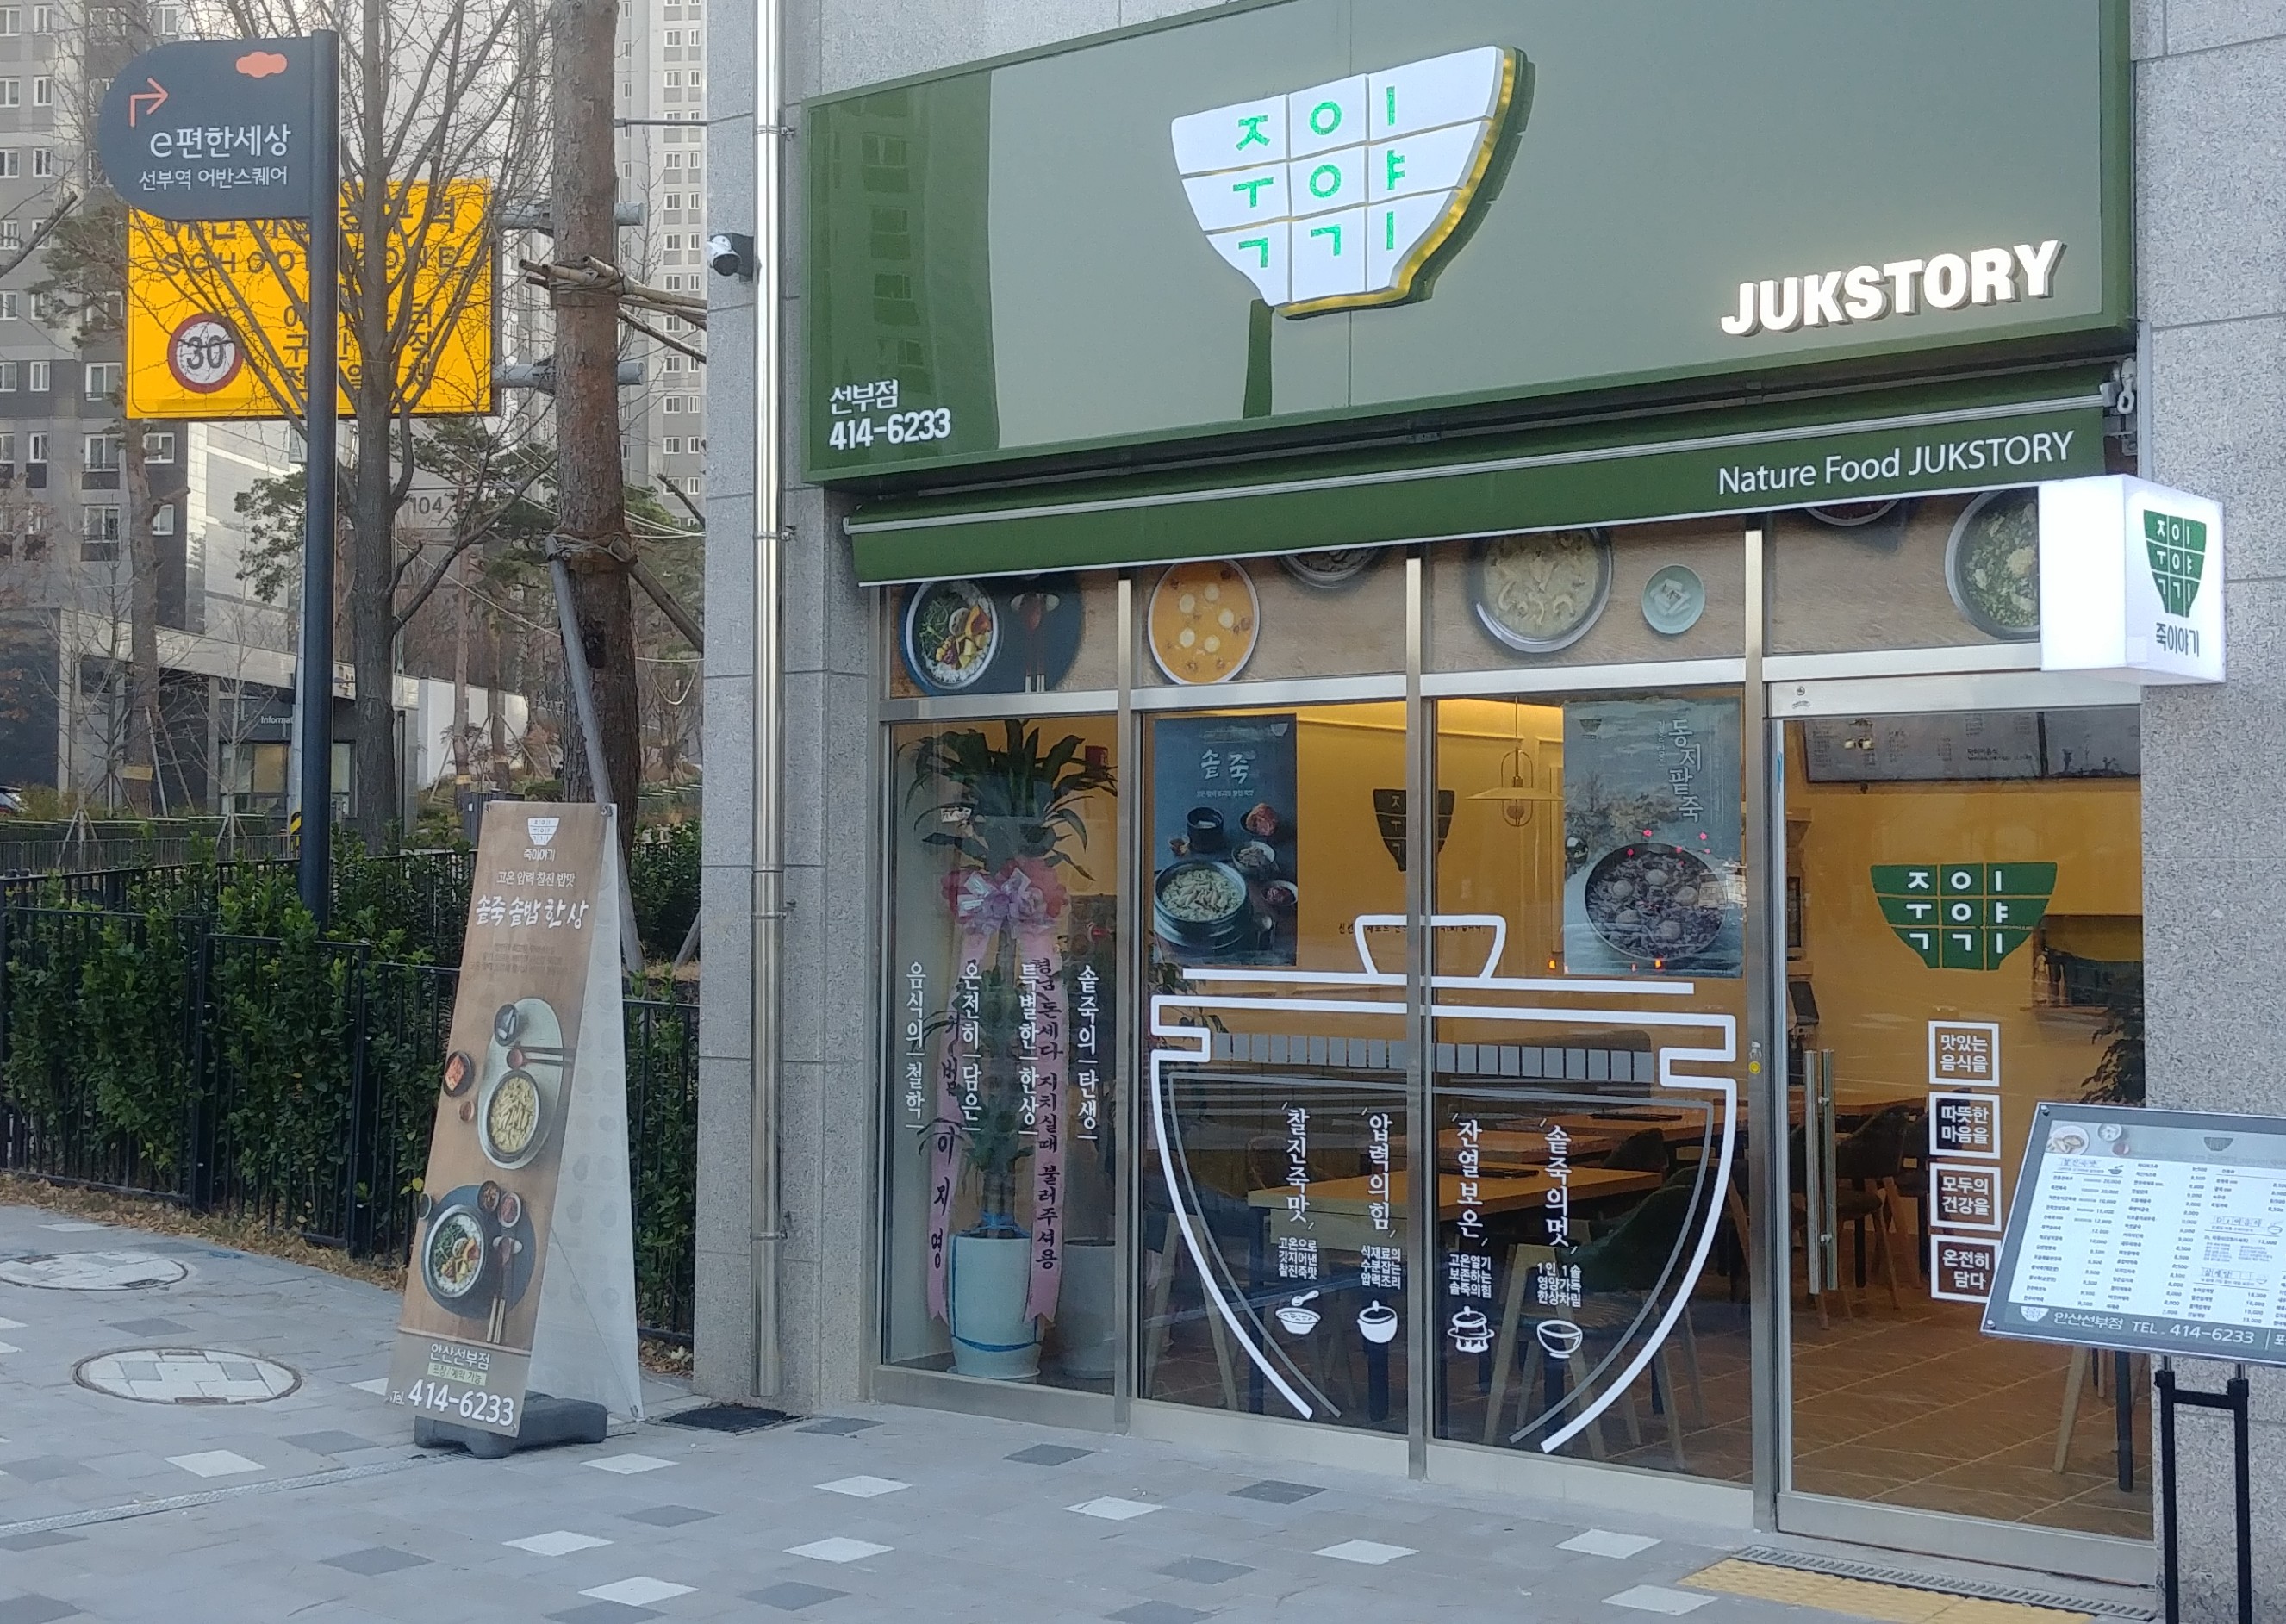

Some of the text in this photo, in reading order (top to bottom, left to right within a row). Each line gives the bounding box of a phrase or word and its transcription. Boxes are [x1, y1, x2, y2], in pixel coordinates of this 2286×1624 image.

[149, 123, 292, 159] e편한세상
[139, 165, 288, 191] 선부역 어반스퀘어
[1720, 240, 2068, 337] JUKSTORY
[185, 334, 227, 370] 30
[829, 378, 900, 415] 선부점
[829, 407, 952, 451] 414-6233
[1718, 430, 2075, 495] Nature Food JUKSTORY
[412, 495, 445, 515] 104
[2155, 622, 2200, 657] 죽이야기
[260, 715, 295, 725] Informat
[523, 848, 556, 862] 죽이야기
[905, 961, 926, 1119] 음식의 철학
[961, 961, 982, 1123] 온전히 담은
[1018, 963, 1039, 1126] 특별한 한상
[1077, 964, 1099, 1129] 솥죽의 탄생
[1940, 1034, 1989, 1053] 맛있는
[1940, 1054, 1989, 1073] 음식을
[1940, 1105, 1990, 1125] 따뜻한
[1940, 1125, 1990, 1145] 마음을
[1941, 1175, 1990, 1196] 모두의
[1941, 1196, 1990, 1216] 건강을
[1278, 1236, 1317, 1252] 고온으로
[1361, 1245, 1401, 1262] 식재료의
[1942, 1248, 1990, 1271] 온전히
[1448, 1267, 1492, 1284] 보존하는
[1953, 1271, 1986, 1291] 담다
[2053, 1311, 2124, 1330] 안산선부점
[2170, 1324, 2255, 1344] 414-6233
[430, 1343, 491, 1371] 안산선부점
[408, 1378, 514, 1427] 414-6233
